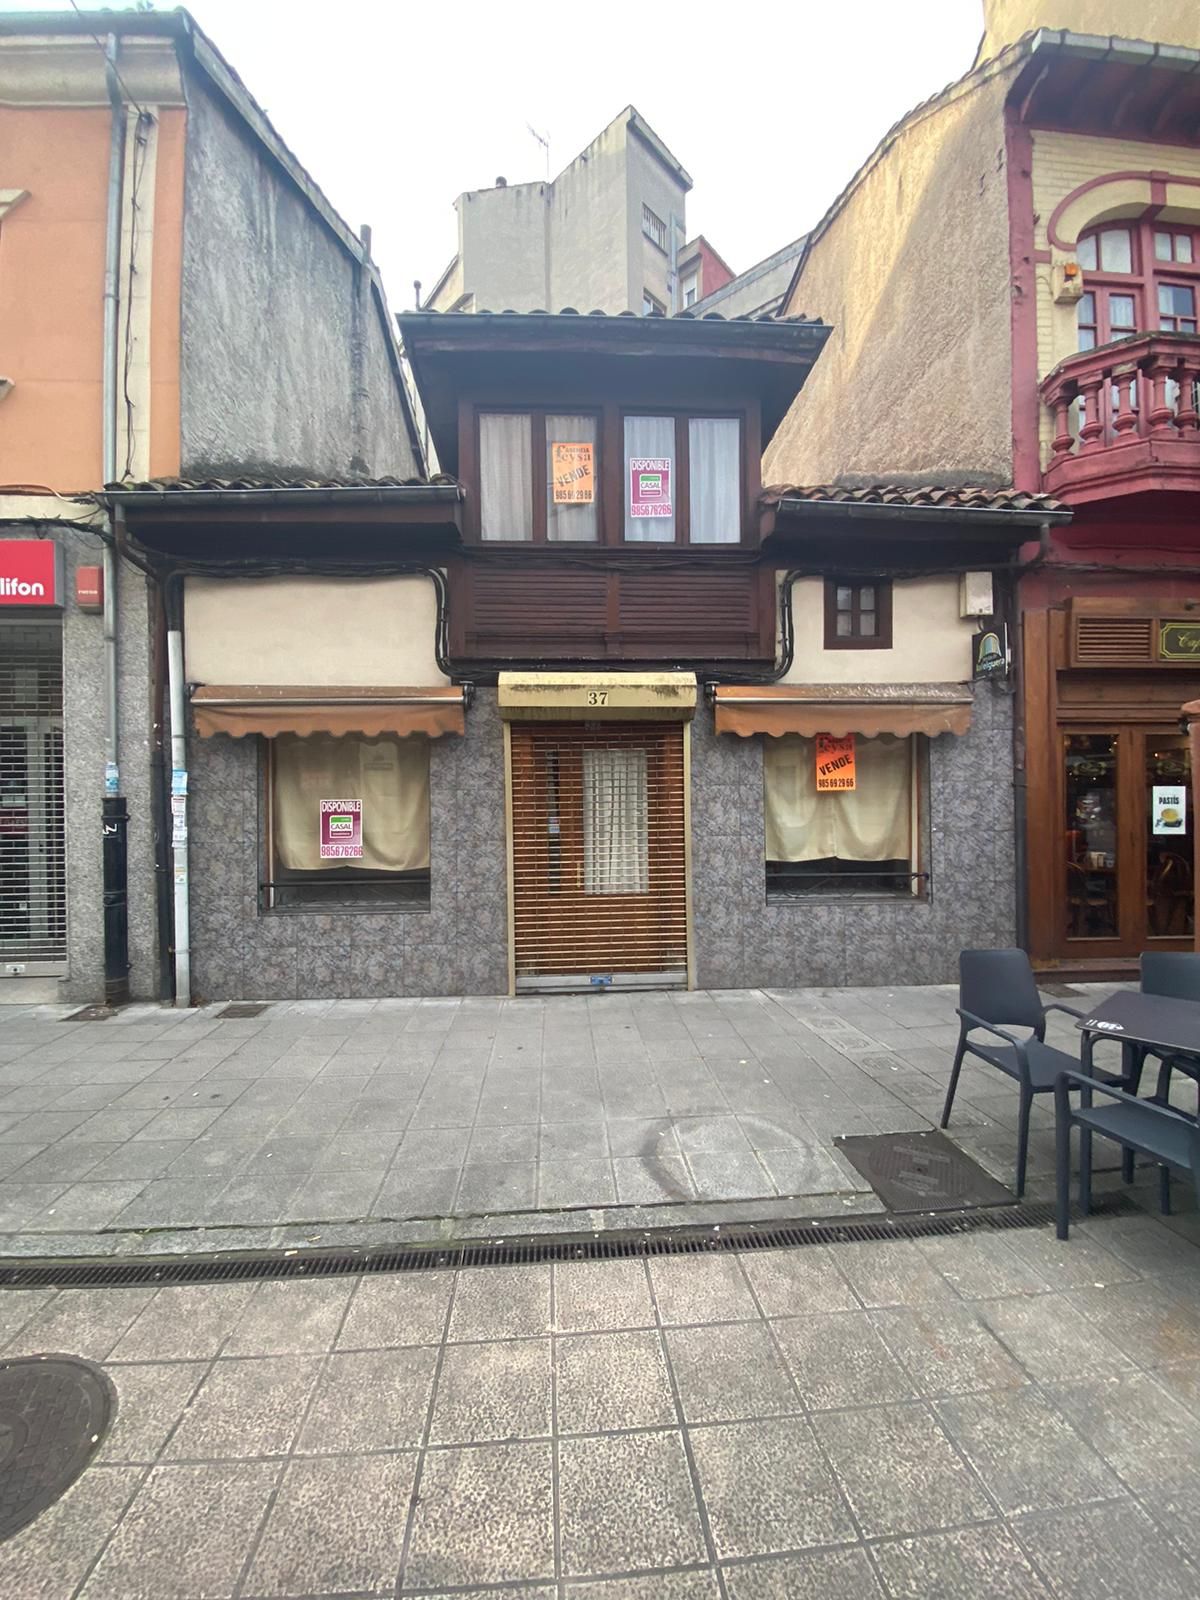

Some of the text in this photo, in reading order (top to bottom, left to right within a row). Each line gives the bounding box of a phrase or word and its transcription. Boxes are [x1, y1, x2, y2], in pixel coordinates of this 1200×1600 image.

[632, 460, 670, 471] DISPONIBLE
[557, 464, 590, 487] VENDE
[588, 692, 608, 705] 37
[819, 754, 853, 776] VENDE
[322, 801, 361, 812] DISPONIBLE
[321, 845, 364, 857] 985676266
